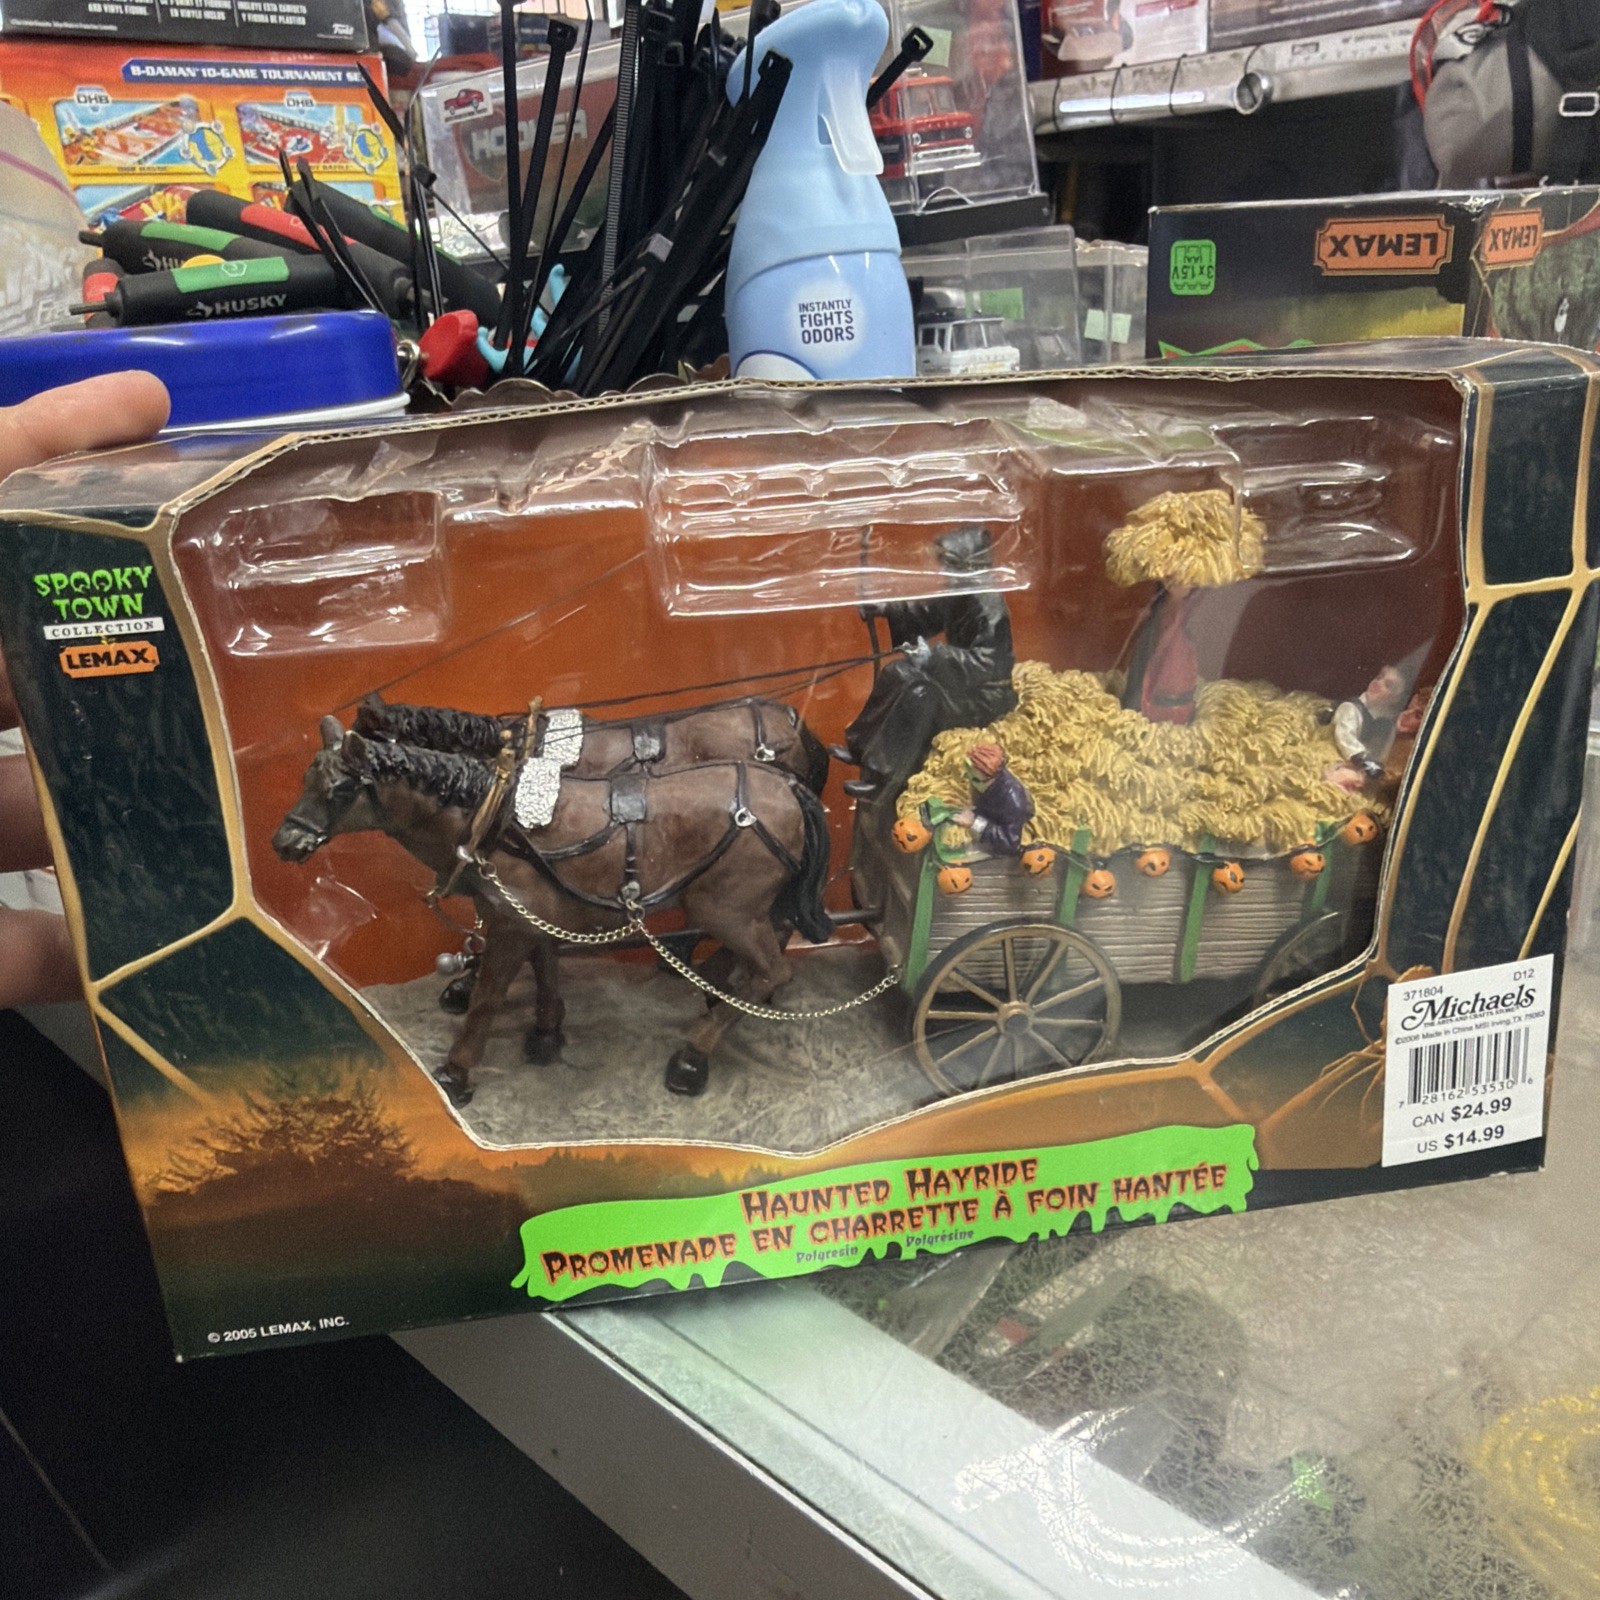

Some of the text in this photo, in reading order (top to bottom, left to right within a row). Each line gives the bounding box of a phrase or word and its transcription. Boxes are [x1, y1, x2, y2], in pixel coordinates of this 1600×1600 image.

[201, 67, 258, 79] 10-GAME
[261, 69, 343, 81] TOURNAMENT
[346, 72, 364, 82] SE
[77, 94, 109, 104] DHB
[1329, 232, 1439, 257] LEMAX
[1489, 224, 1538, 252] LEMAX
[215, 294, 287, 315] HUSKY
[798, 299, 852, 313] INSTANTLY
[800, 310, 854, 328] FIGHTS
[801, 326, 855, 344] ODORS
[33, 565, 153, 597] SPOOKY
[52, 593, 143, 620] TOWN
[52, 620, 154, 638] COLLECTION
[66, 647, 151, 669] LEMAX
[1513, 968, 1535, 982] D12
[1403, 985, 1443, 1001] 371804
[1401, 984, 1536, 1031] Michaels
[1469, 1011, 1494, 1019] CRAFTS
[1422, 1030, 1442, 1039] Made
[1452, 1025, 1473, 1034] China
[1421, 1090, 1465, 1105] 28162
[1471, 1080, 1514, 1096] 53530
[1412, 1097, 1512, 1128] CAN $24.99
[1417, 1125, 1504, 1154] US $14.99
[740, 1157, 1039, 1225] HAUNTED HAYRIDE
[541, 1161, 1228, 1285] PROMENADE EN CHARRETTE À FOIN HANTÉE
[796, 1244, 859, 1263] Polyresin
[223, 1327, 257, 1342] 2005
[260, 1320, 316, 1337] LEMAX,
[319, 1316, 350, 1329] INC.
